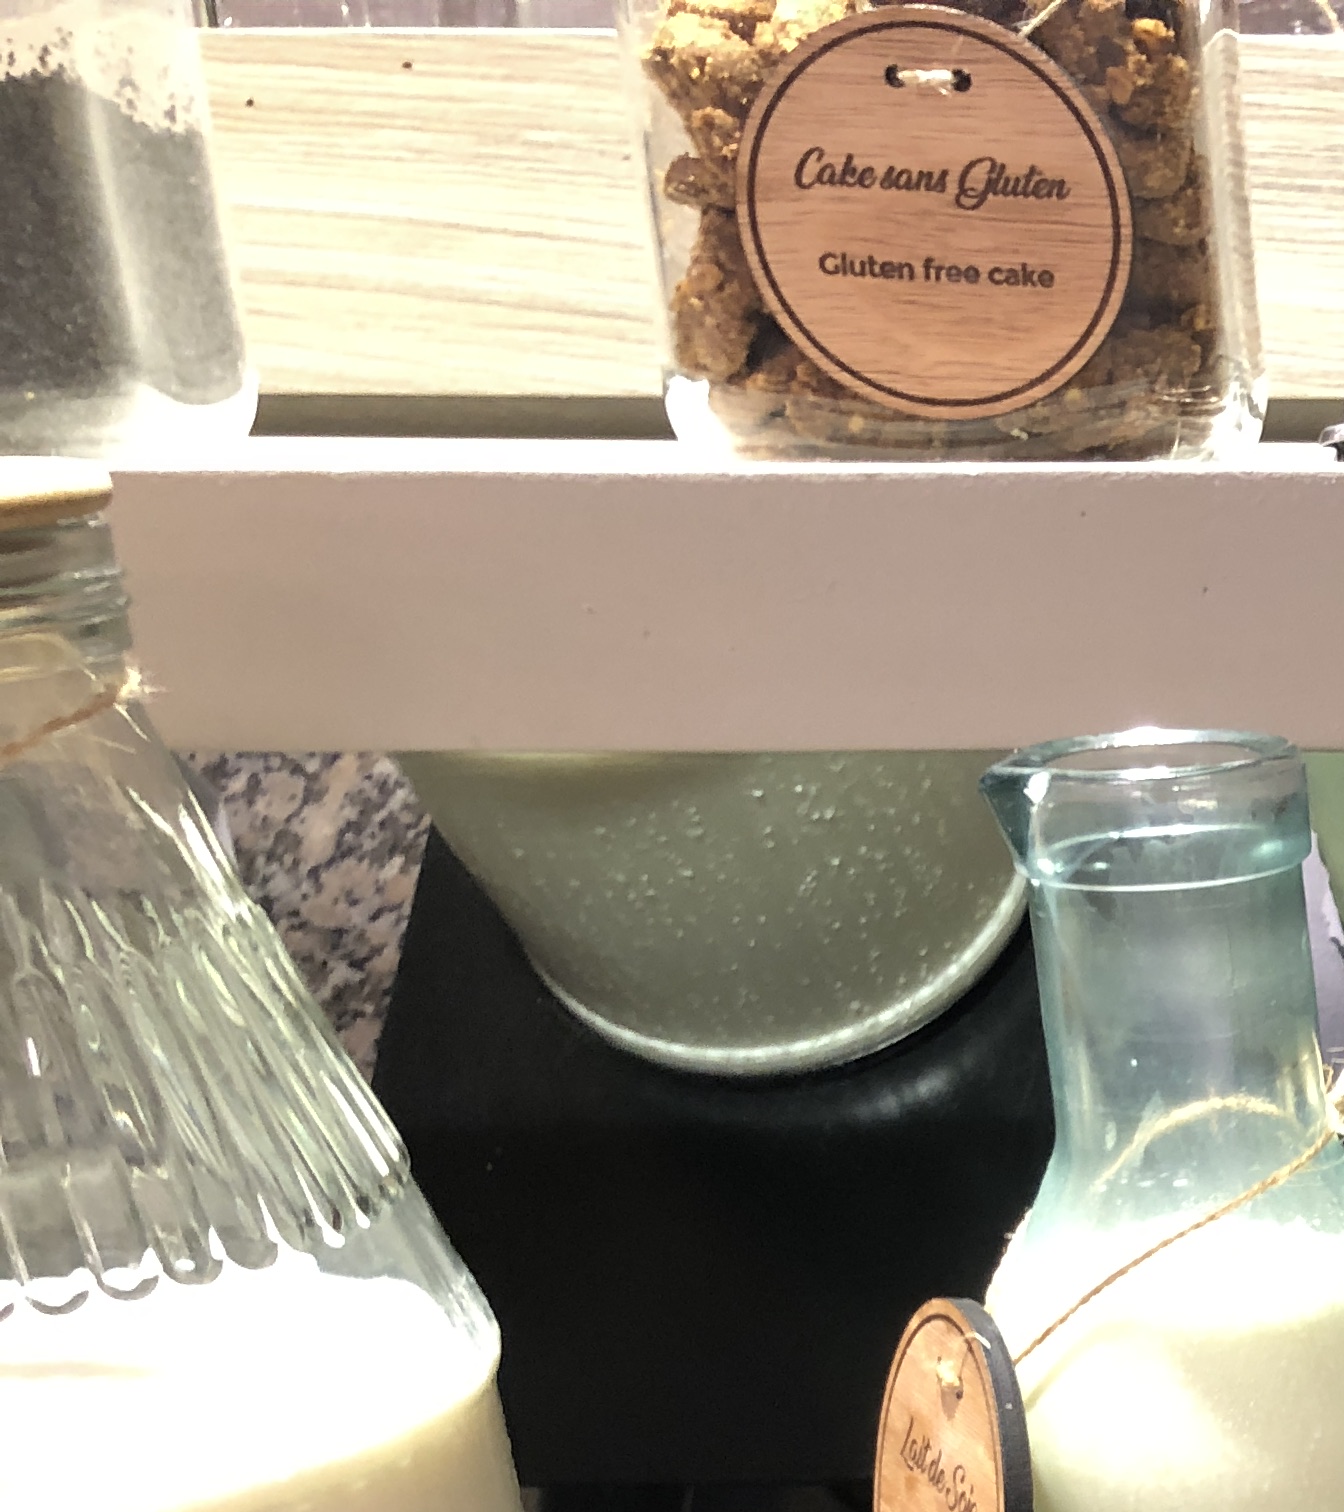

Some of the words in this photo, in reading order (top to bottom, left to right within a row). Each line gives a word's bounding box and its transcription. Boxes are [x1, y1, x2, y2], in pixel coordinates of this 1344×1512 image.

[794, 146, 877, 191] Cake
[879, 165, 949, 194] sans
[955, 156, 1071, 211] Gluten
[818, 251, 916, 283] Gluten
[922, 257, 983, 285] free
[988, 262, 1056, 290] cake
[900, 1416, 931, 1474] Lait
[927, 1449, 946, 1494] de
